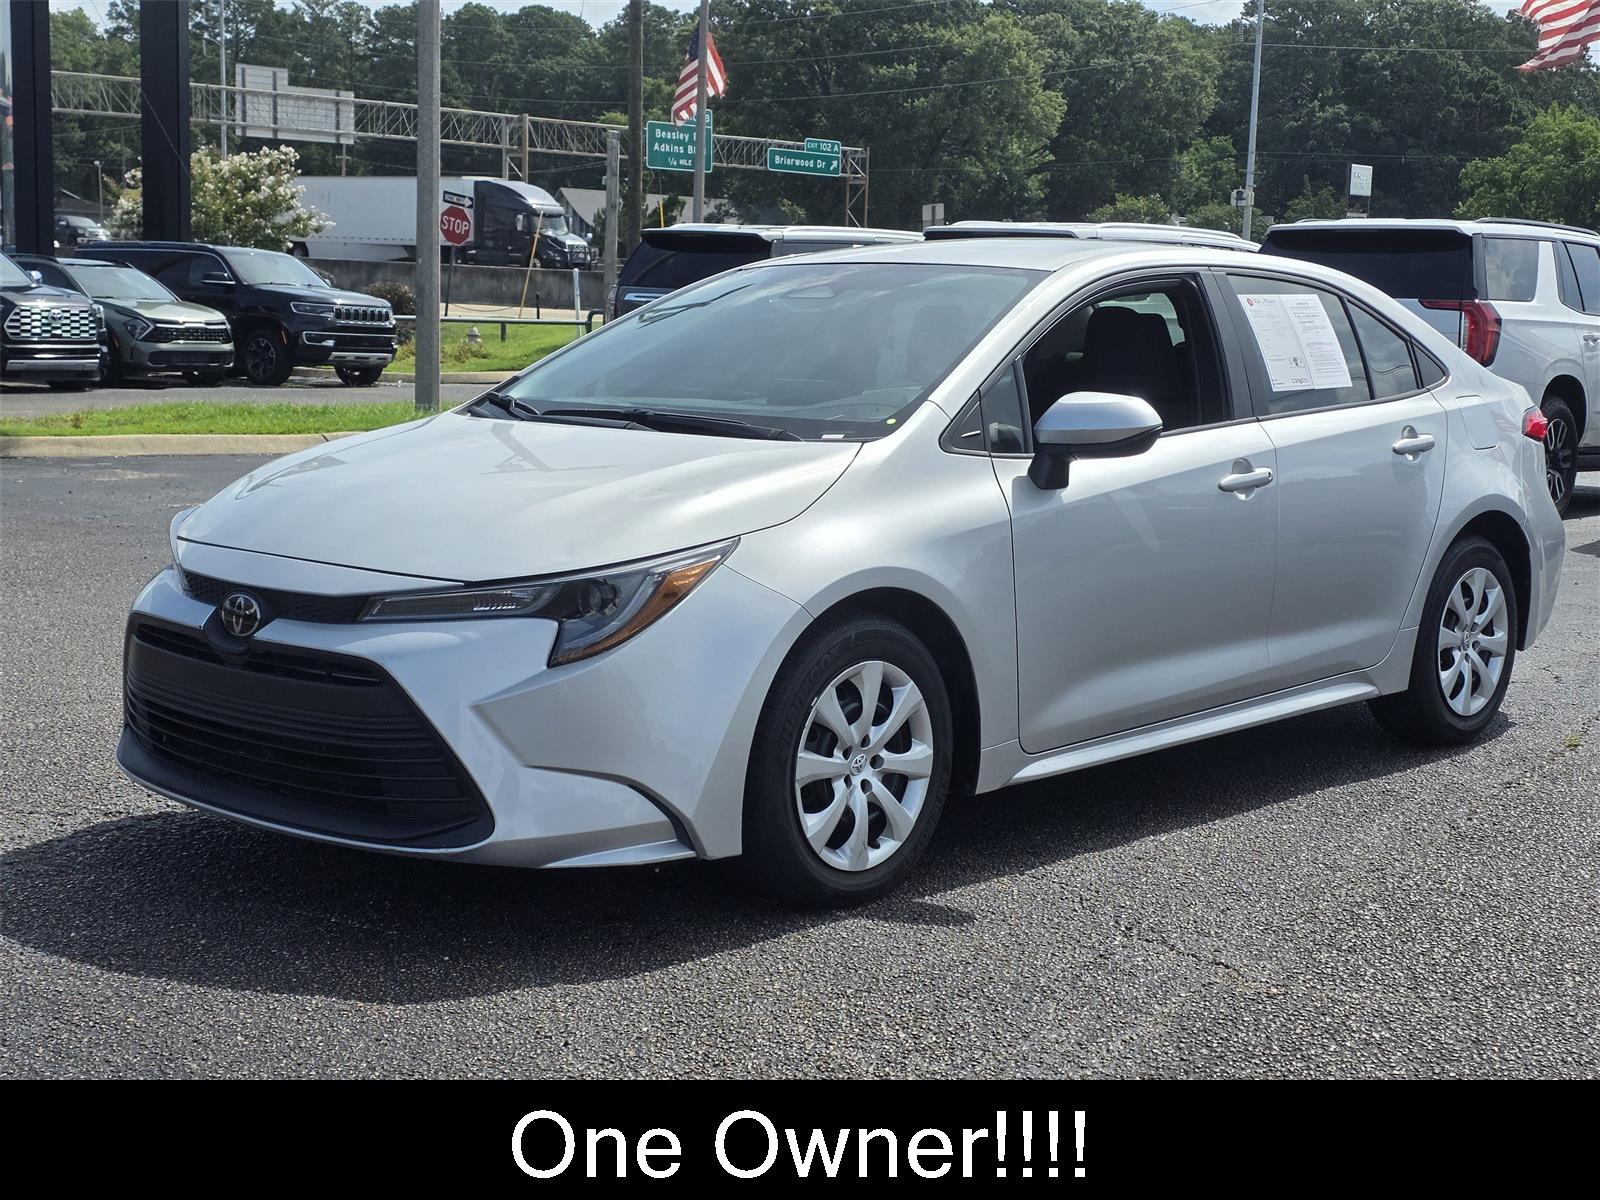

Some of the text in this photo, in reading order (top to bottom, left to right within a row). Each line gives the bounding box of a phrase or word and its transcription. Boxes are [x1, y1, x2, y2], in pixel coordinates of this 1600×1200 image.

[655, 128, 690, 142] Beasley
[653, 142, 684, 153] Adkins
[819, 142, 832, 152] 102
[833, 144, 839, 152] A
[774, 155, 826, 169] Briarwood Dr
[441, 215, 469, 235] STOP
